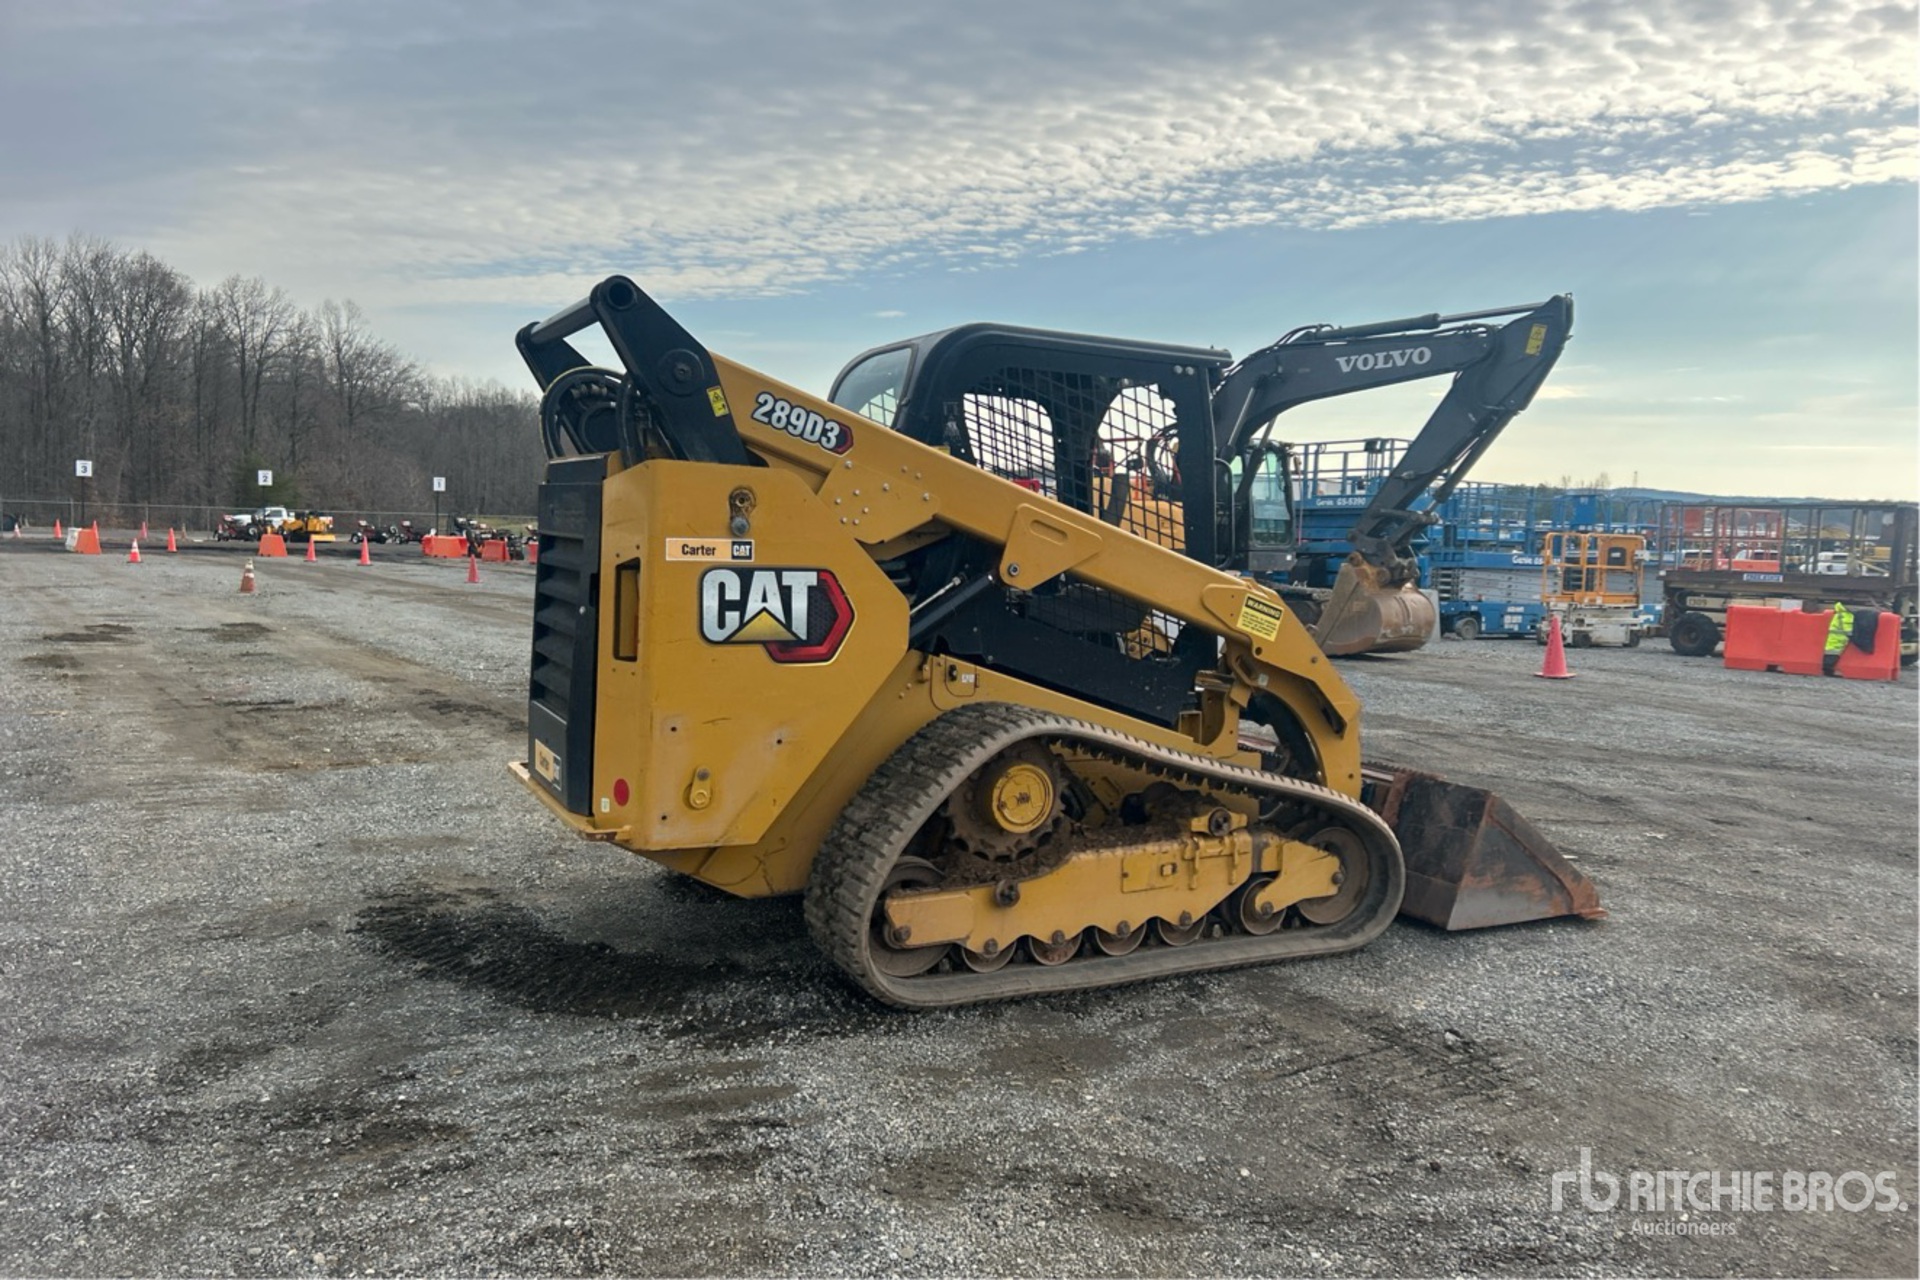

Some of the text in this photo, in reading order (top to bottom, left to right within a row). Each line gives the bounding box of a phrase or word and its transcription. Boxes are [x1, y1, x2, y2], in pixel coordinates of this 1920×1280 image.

[1335, 347, 1432, 373] VOLVO
[752, 392, 841, 450] 289D3
[681, 543, 752, 557] Carter CAT
[1512, 555, 1533, 565] Genie
[702, 569, 818, 642] CAT
[1246, 598, 1282, 619] WARNING
